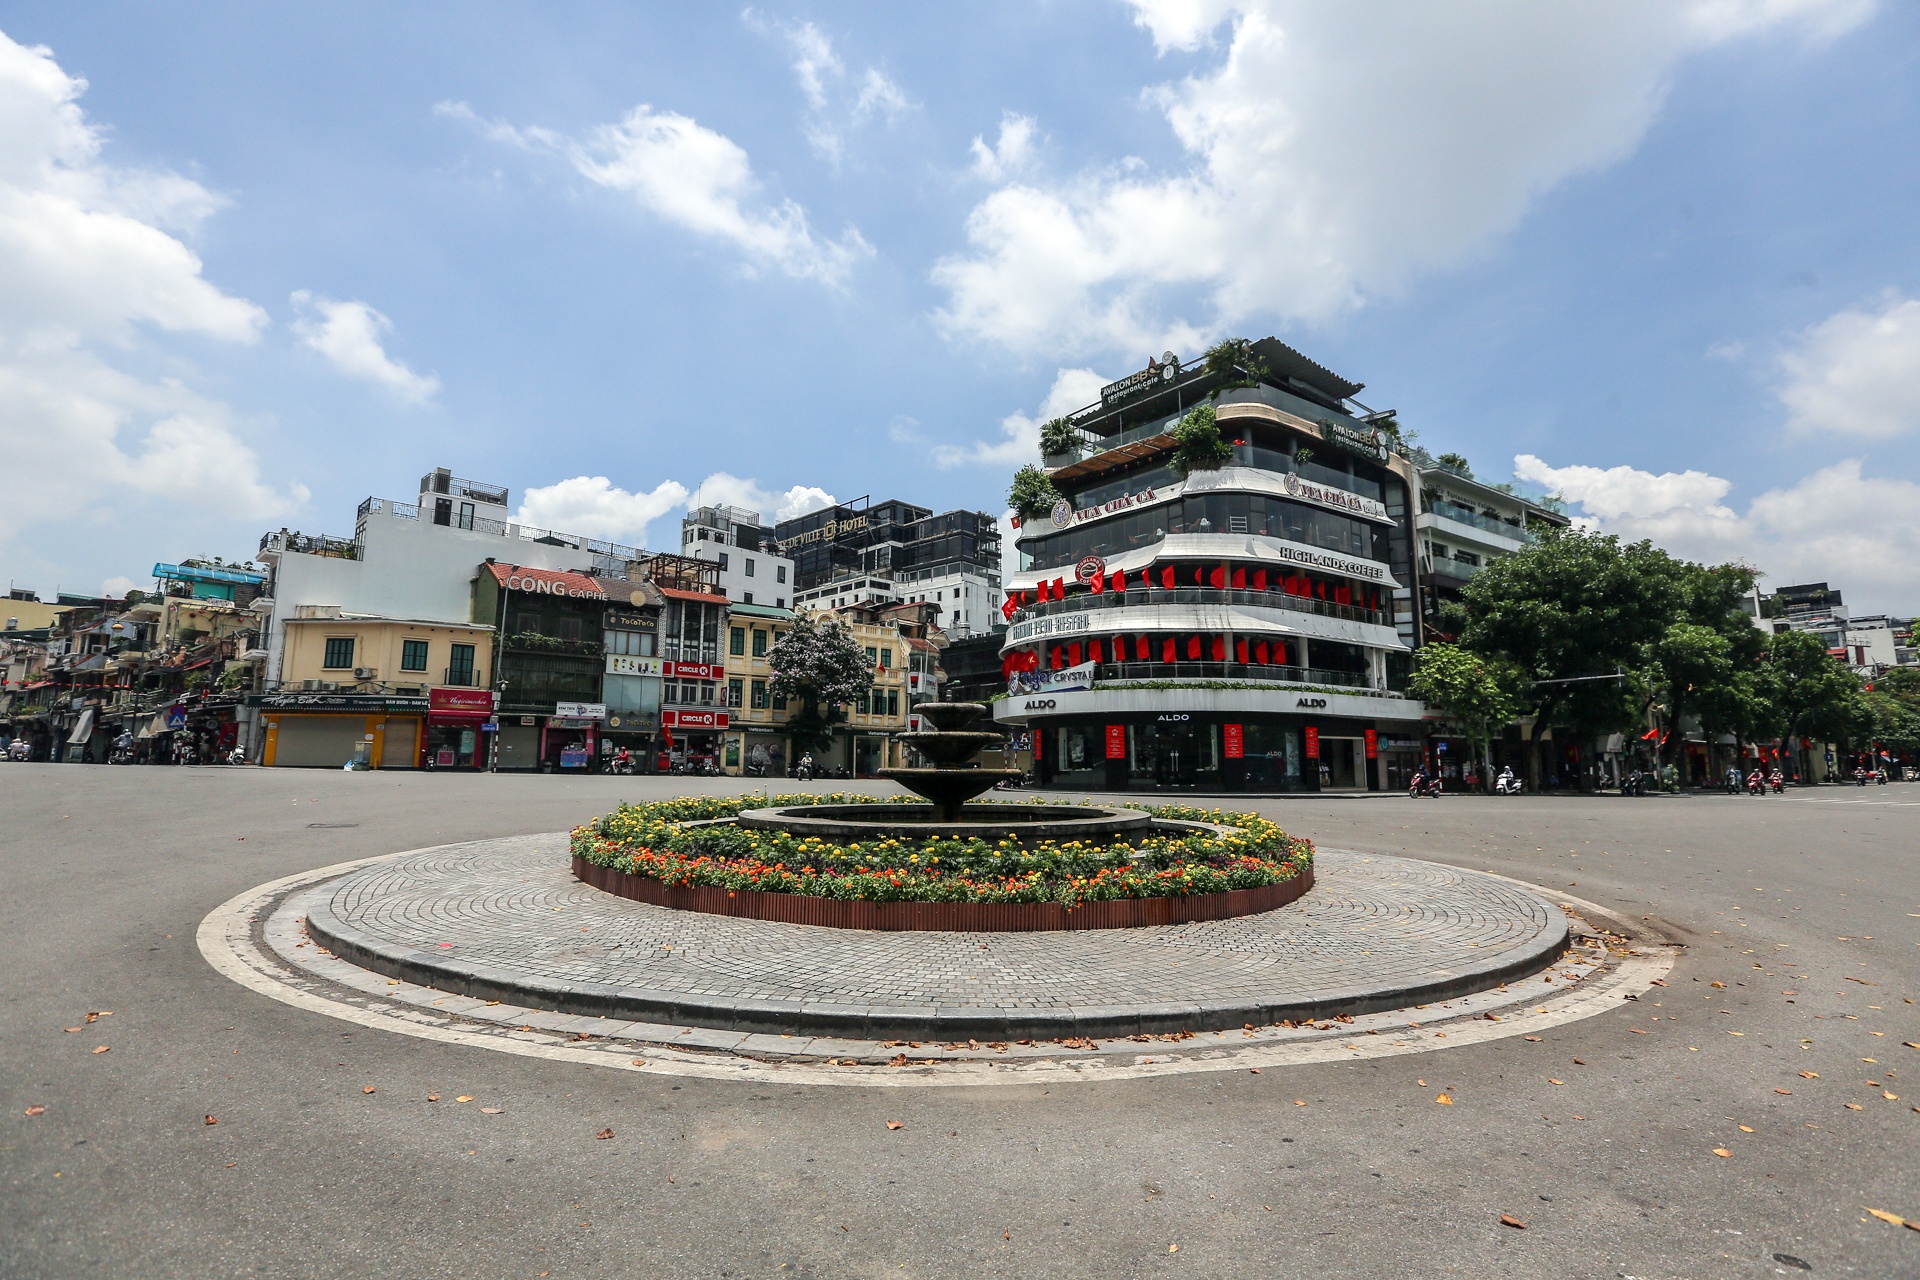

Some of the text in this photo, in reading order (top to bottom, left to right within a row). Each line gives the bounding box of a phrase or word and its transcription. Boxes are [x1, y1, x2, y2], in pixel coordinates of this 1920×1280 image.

[1102, 379, 1131, 397] AVALON
[1332, 423, 1359, 440] AVALON
[1301, 484, 1322, 502] VUA
[1076, 504, 1102, 521] VUA
[788, 535, 799, 548] DE
[800, 528, 821, 546] VILLE
[839, 515, 869, 533] HOTEL
[1281, 547, 1383, 578] HIGHLANDS COFFEE
[568, 587, 610, 602] CAPHE
[1034, 618, 1053, 635] 1930
[1055, 613, 1089, 632] BISTRO
[700, 666, 708, 676] K
[1021, 669, 1094, 691] Tiger CRYSTAL
[1025, 699, 1056, 709] ALDO
[1296, 698, 1327, 708] ALDO
[681, 715, 713, 724] CIRCLE K
[1019, 743, 1032, 751] Caf
